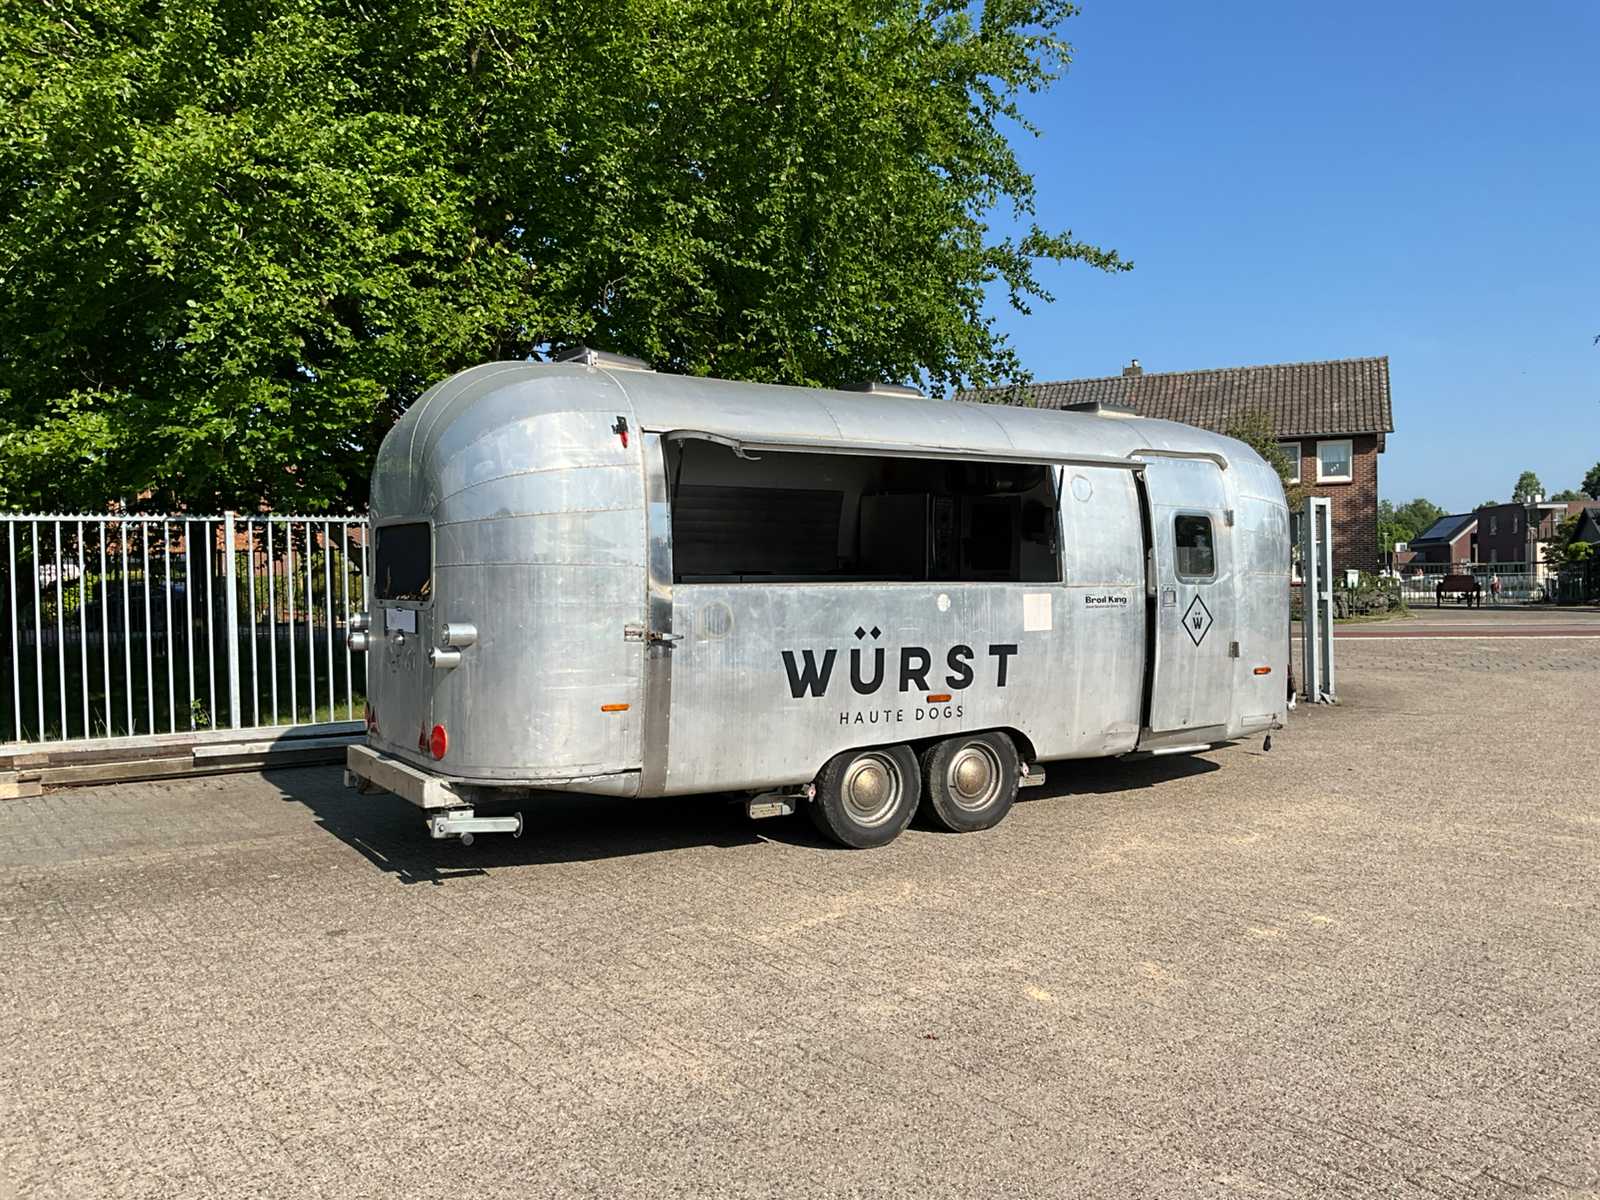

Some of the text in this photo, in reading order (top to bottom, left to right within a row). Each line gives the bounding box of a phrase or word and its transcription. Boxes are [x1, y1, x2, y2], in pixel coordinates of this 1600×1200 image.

[781, 626, 1018, 698] WÜRST
[839, 705, 964, 725] HAUTE DOGS
